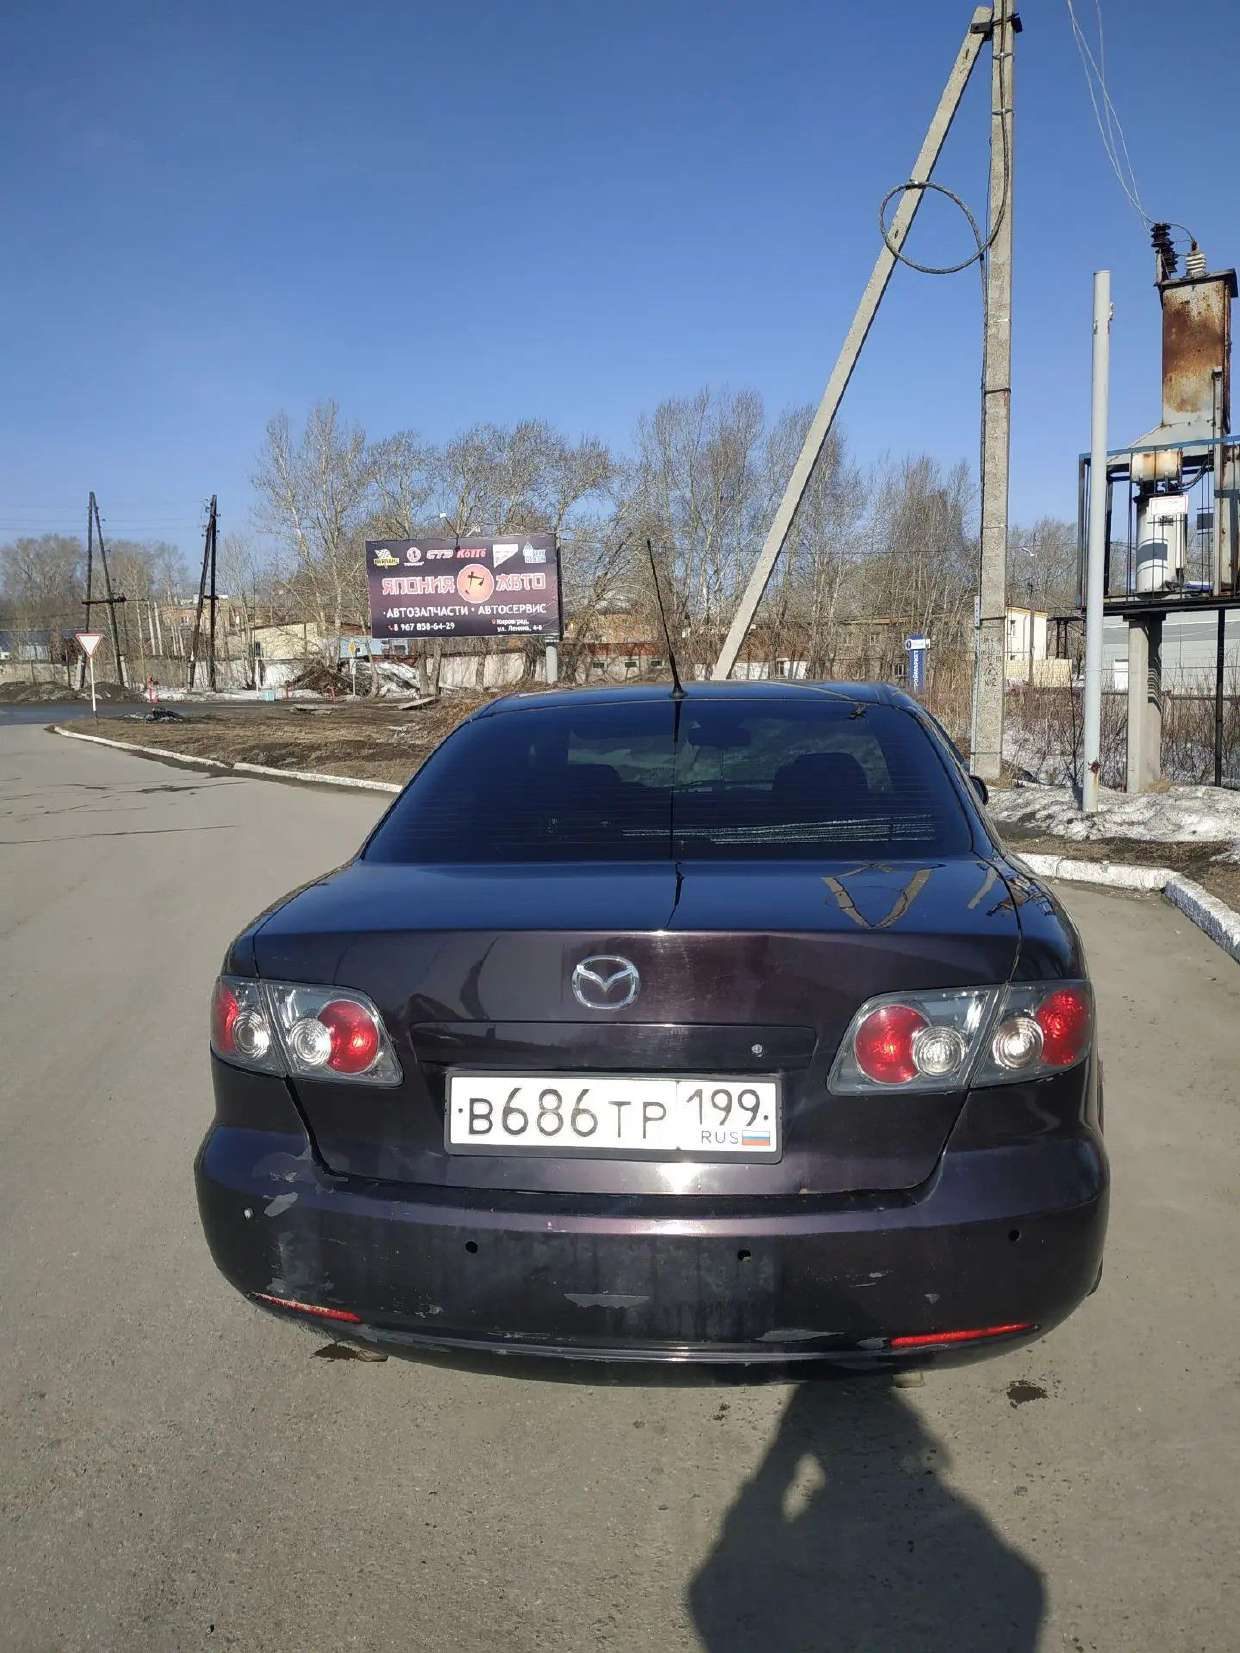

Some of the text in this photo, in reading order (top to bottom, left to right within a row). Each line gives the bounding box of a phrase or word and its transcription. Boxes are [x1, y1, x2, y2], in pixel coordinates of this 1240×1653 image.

[382, 573, 545, 595] ЯПОНИЯ АВТО
[386, 604, 546, 618] АВТОЗАПЧАСТИ АВТОСЕРВИС
[400, 623, 415, 631] 967
[686, 1088, 761, 1127] 199
[701, 1130, 738, 1145] RUS
